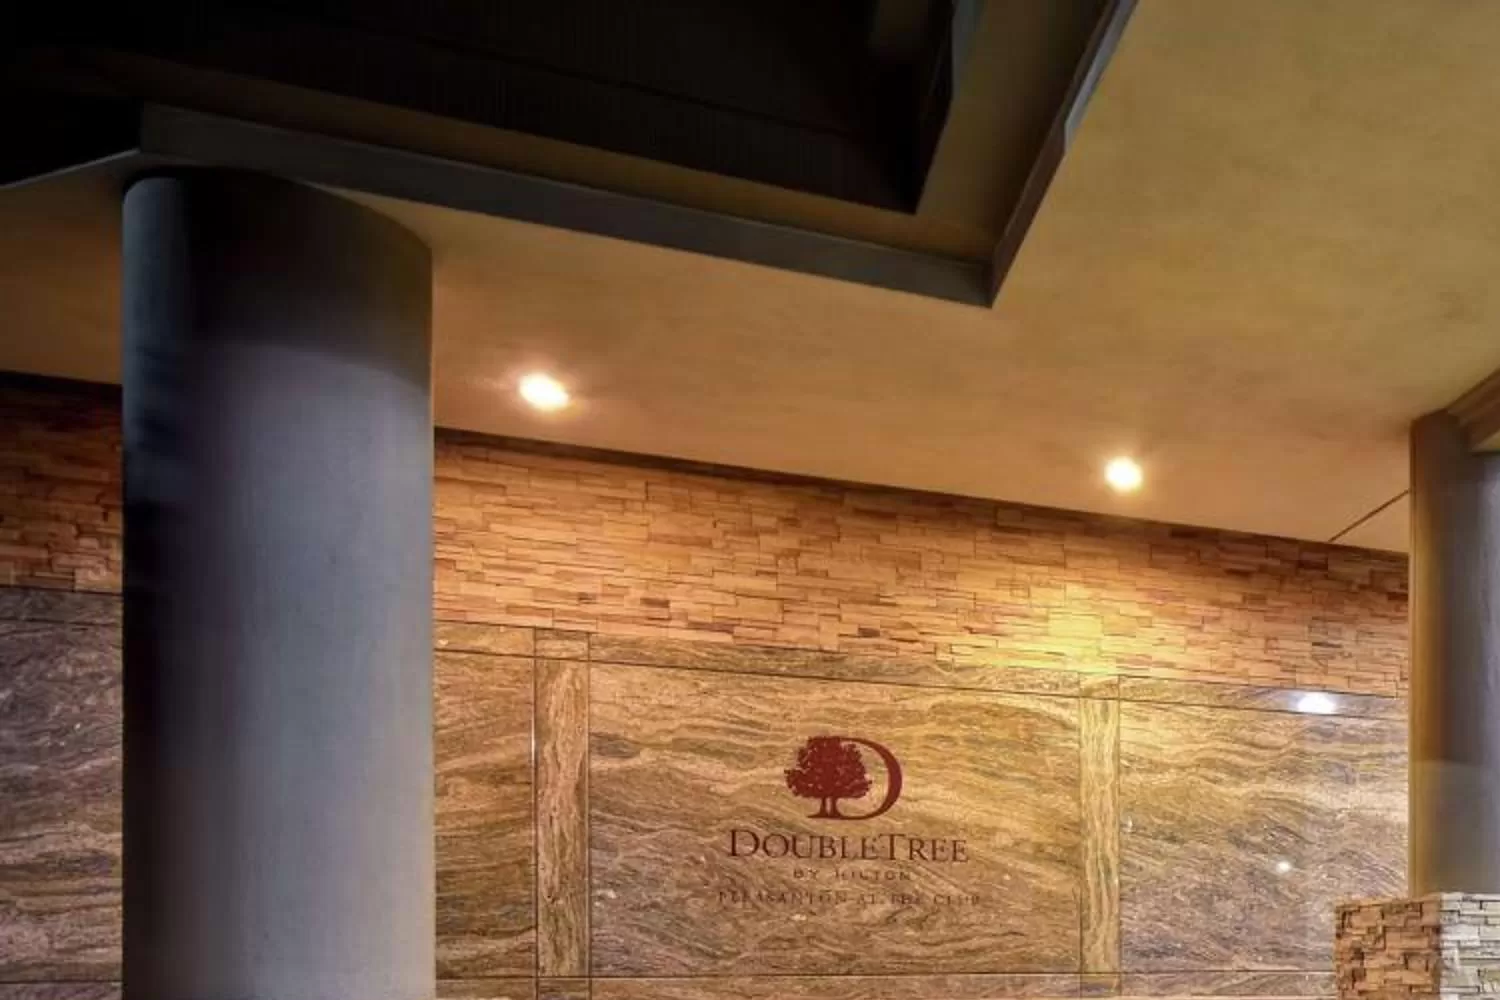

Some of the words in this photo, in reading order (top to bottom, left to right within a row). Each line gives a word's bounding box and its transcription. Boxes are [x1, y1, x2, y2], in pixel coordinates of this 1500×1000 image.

[728, 829, 971, 863] DOUBLETREE
[793, 868, 818, 881] BY
[835, 867, 912, 882] HILTON
